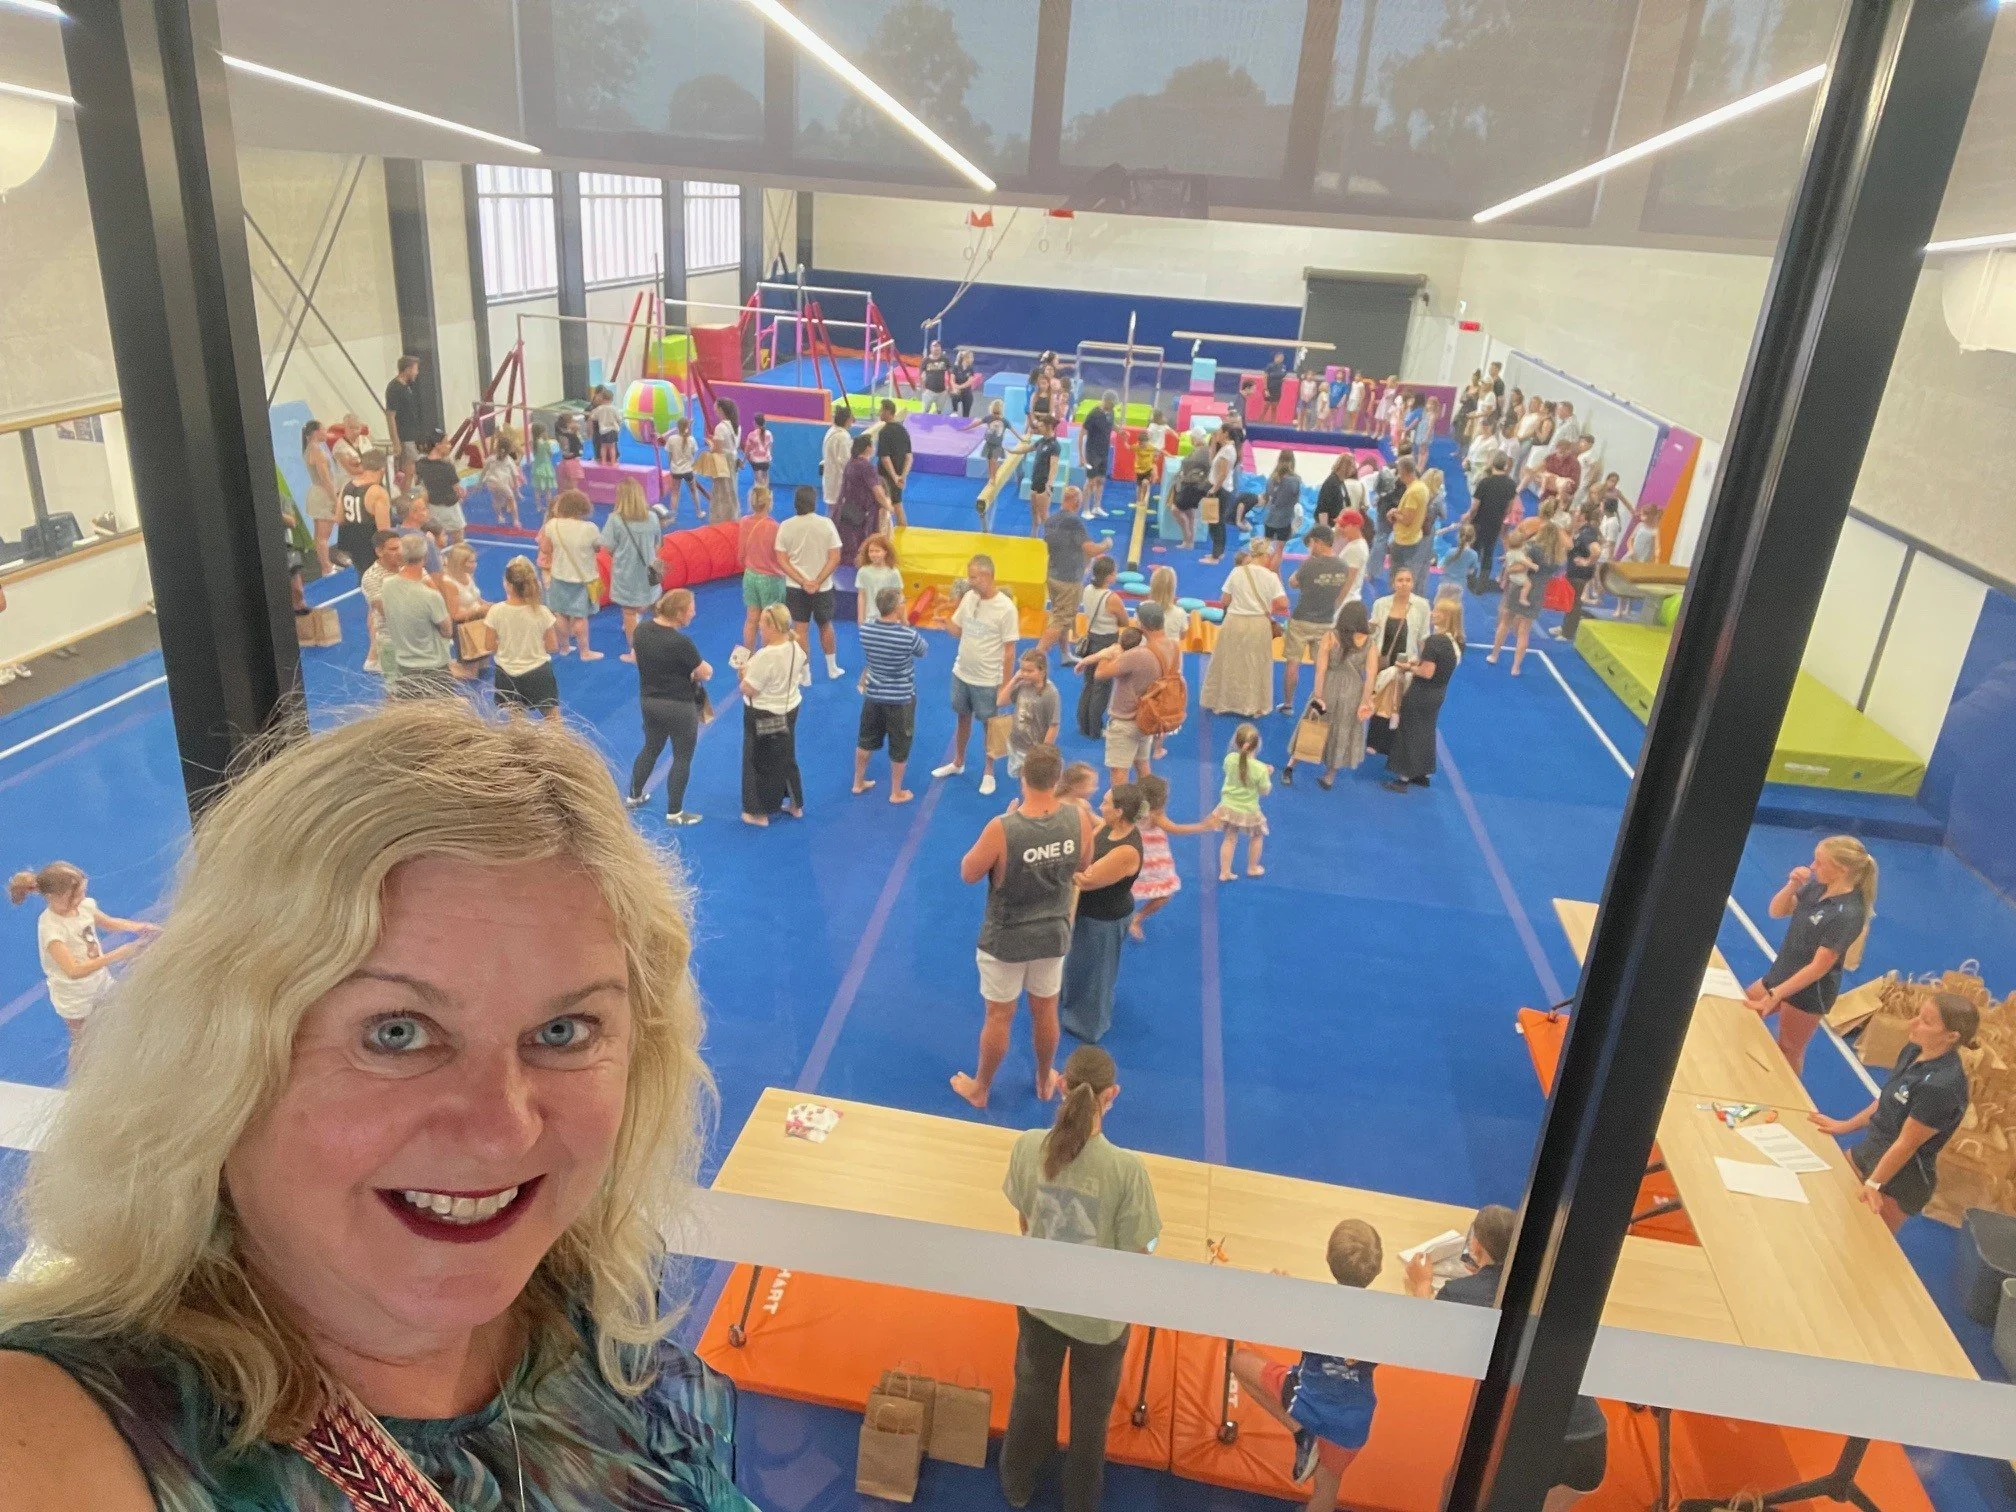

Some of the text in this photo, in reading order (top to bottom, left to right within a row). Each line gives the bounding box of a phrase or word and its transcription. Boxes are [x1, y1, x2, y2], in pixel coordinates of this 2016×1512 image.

[343, 494, 362, 523] 91
[1022, 841, 1061, 863] ONE
[1062, 839, 1075, 855] 8
